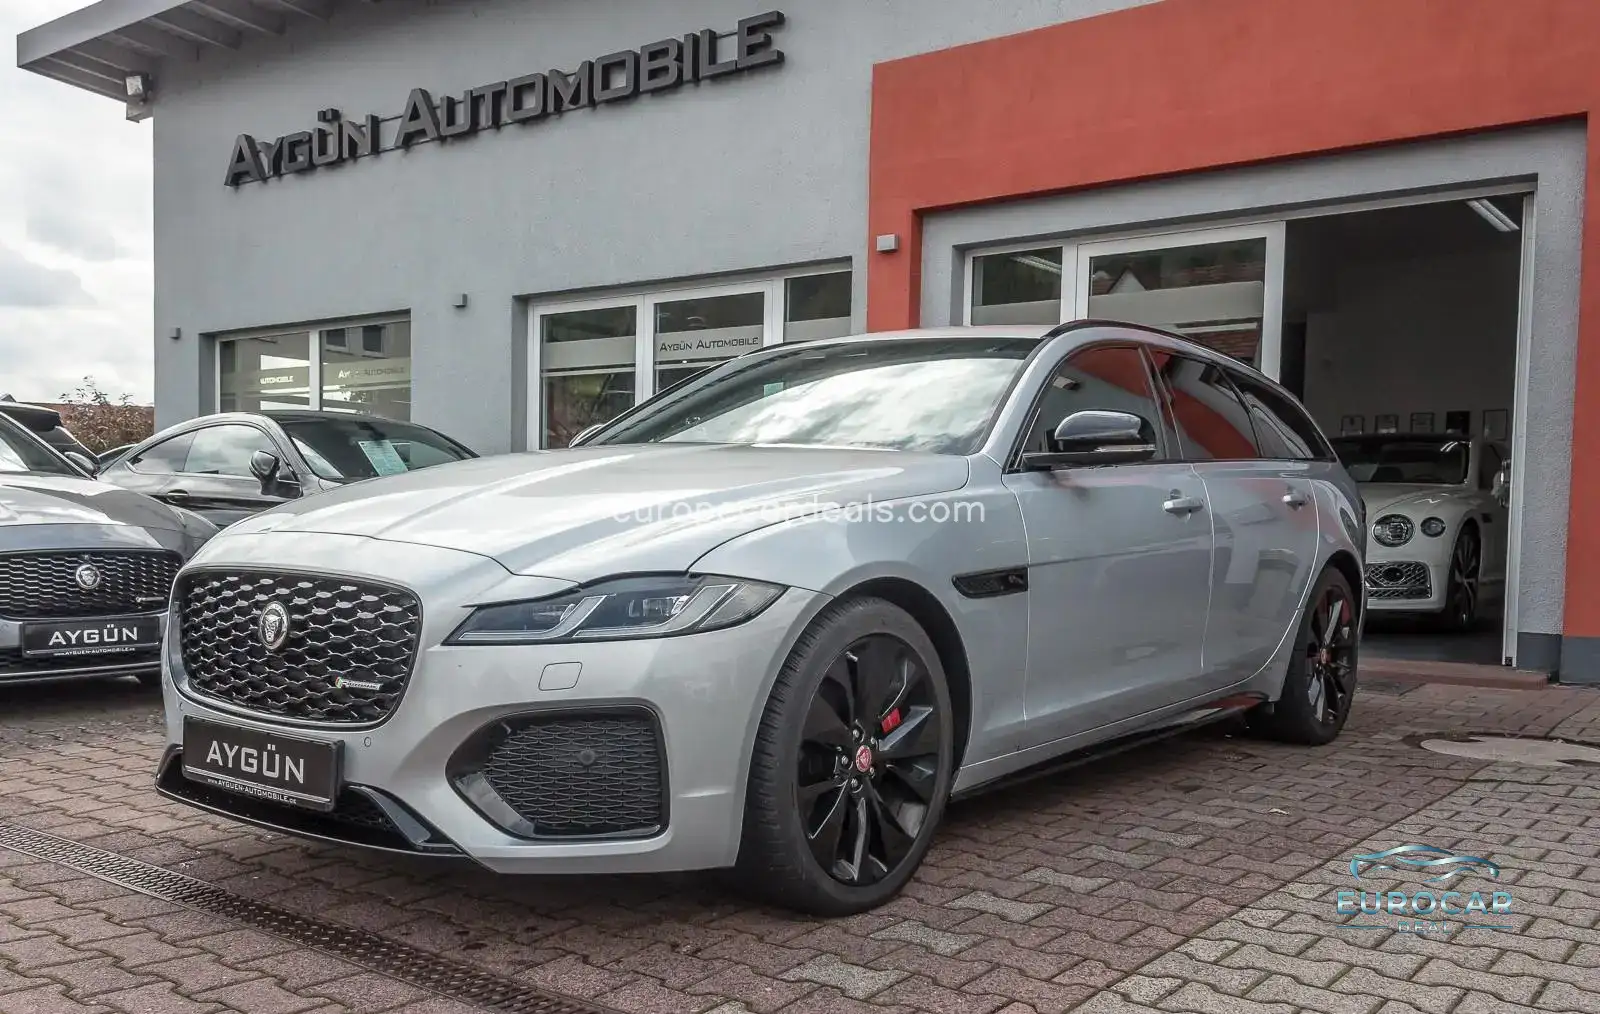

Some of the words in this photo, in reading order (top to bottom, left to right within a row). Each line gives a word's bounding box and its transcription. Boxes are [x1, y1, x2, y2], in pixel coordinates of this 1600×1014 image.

[224, 108, 379, 186] AYGÜN
[394, 10, 785, 146] AUTOMOBILE
[659, 340, 692, 352] AYGÜN
[696, 337, 759, 349] AUTOMOBILE
[48, 623, 138, 646] AYGÜN
[206, 740, 305, 784] AYGÜN
